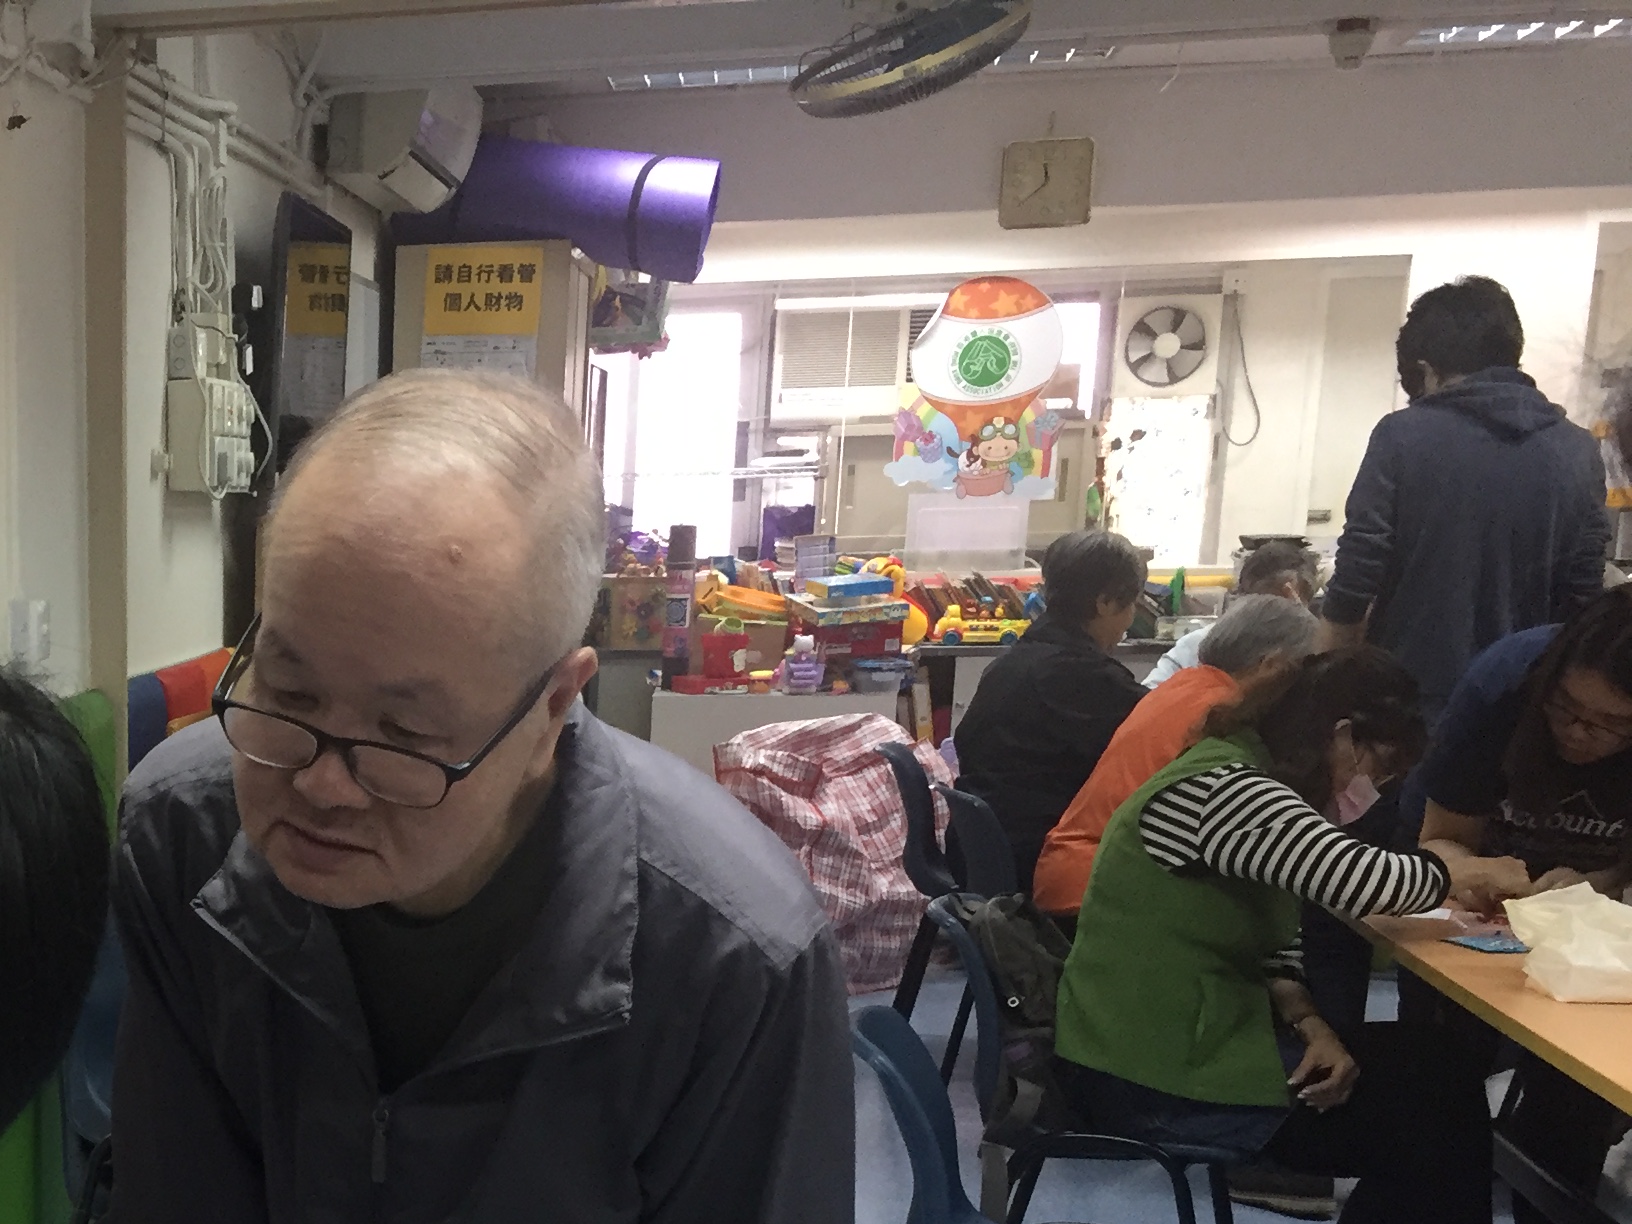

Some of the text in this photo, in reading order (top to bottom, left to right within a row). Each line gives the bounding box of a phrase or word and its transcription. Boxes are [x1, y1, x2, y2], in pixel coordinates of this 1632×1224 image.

[434, 262, 537, 284] 請自行看管
[443, 290, 524, 312] 個人財物
